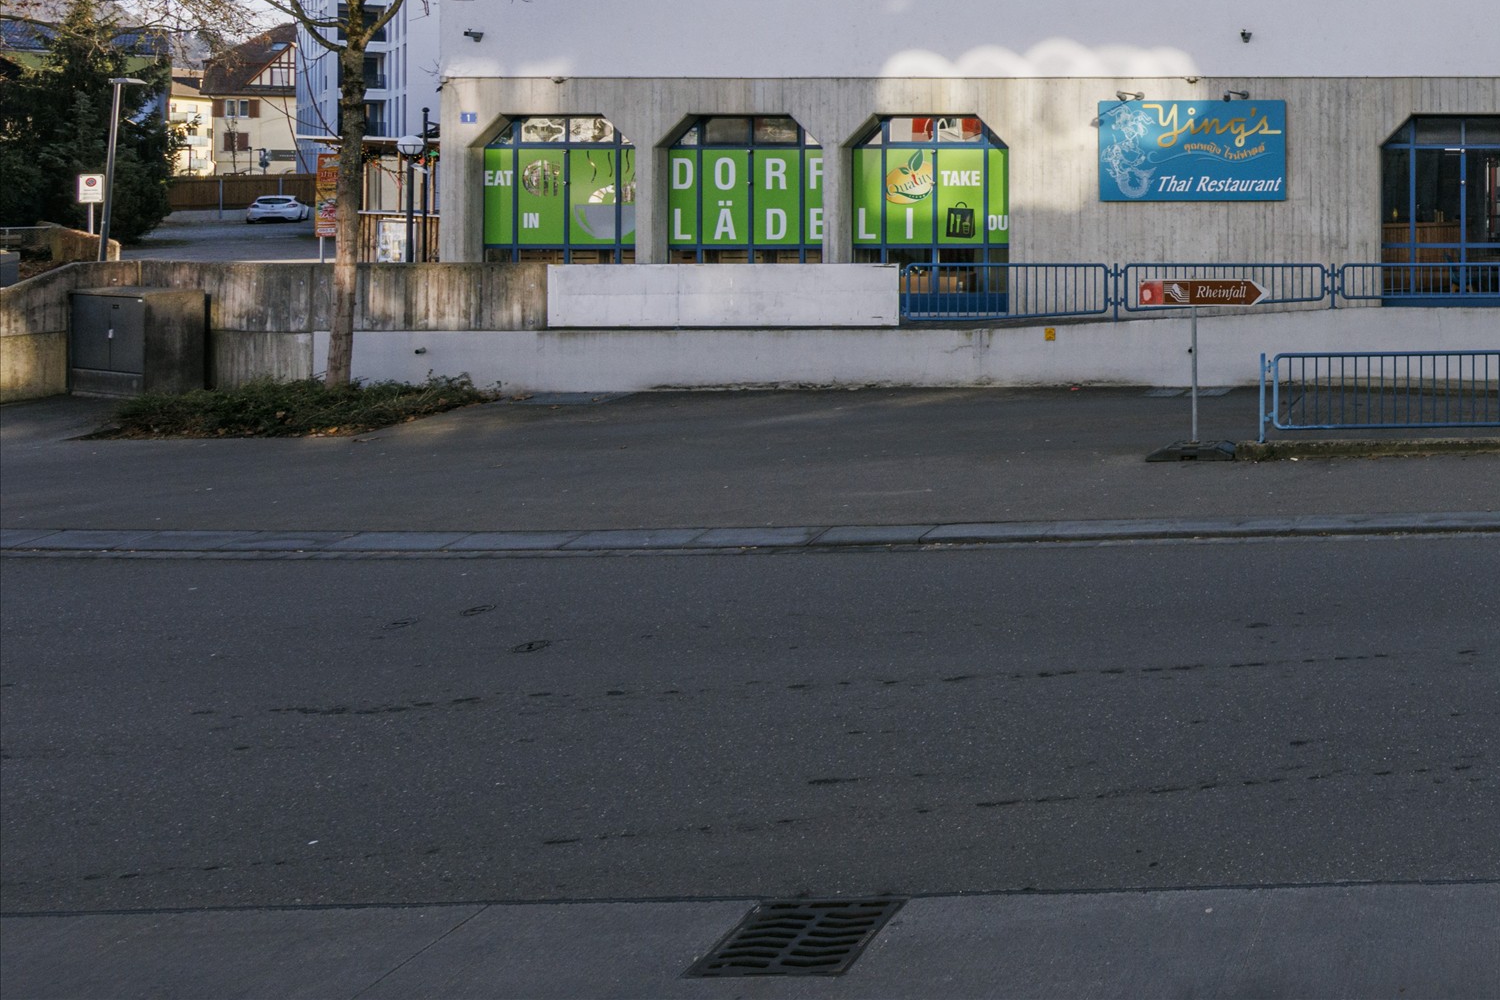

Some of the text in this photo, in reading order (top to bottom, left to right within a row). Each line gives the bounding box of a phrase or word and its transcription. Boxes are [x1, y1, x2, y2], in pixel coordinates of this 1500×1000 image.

[466, 114, 471, 122] 1
[484, 170, 513, 186] EAT
[672, 157, 823, 190] DORF
[940, 170, 981, 186] TAKE
[887, 172, 934, 197] Quality
[1157, 175, 1282, 192] Thai Restaurant
[523, 212, 539, 228] IN
[988, 215, 1008, 231] OU
[1196, 284, 1246, 300] Rheinfall
